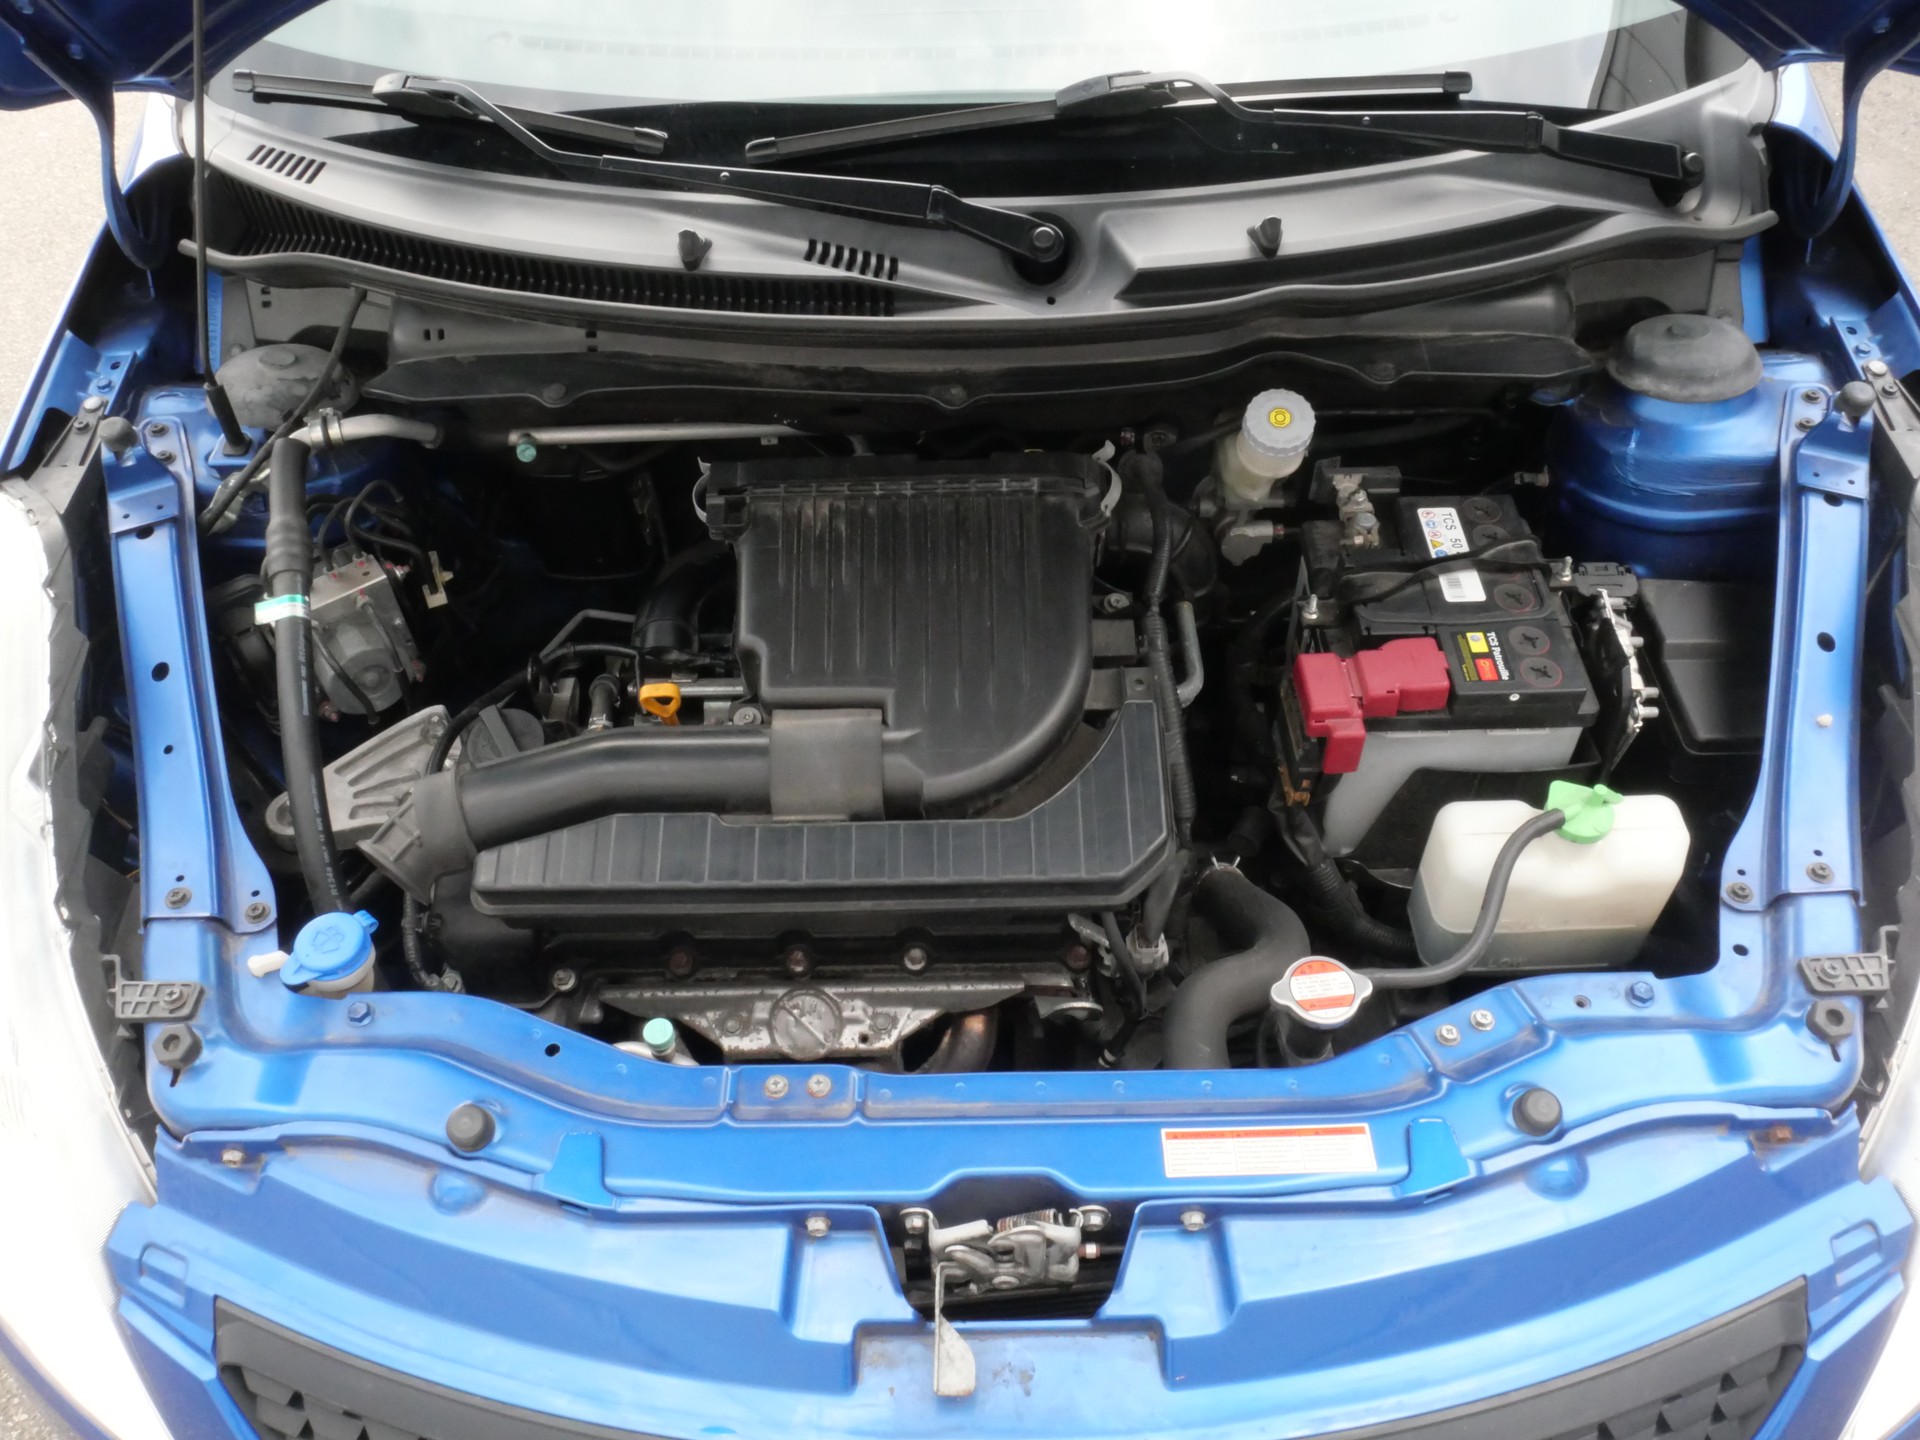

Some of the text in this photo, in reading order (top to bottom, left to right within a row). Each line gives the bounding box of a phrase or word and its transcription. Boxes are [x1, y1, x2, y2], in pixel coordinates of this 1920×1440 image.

[1441, 512, 1463, 549] TCS 50
[1486, 631, 1499, 646] TCS
[1491, 647, 1510, 681] Patrouille
[325, 866, 339, 896] R134a
